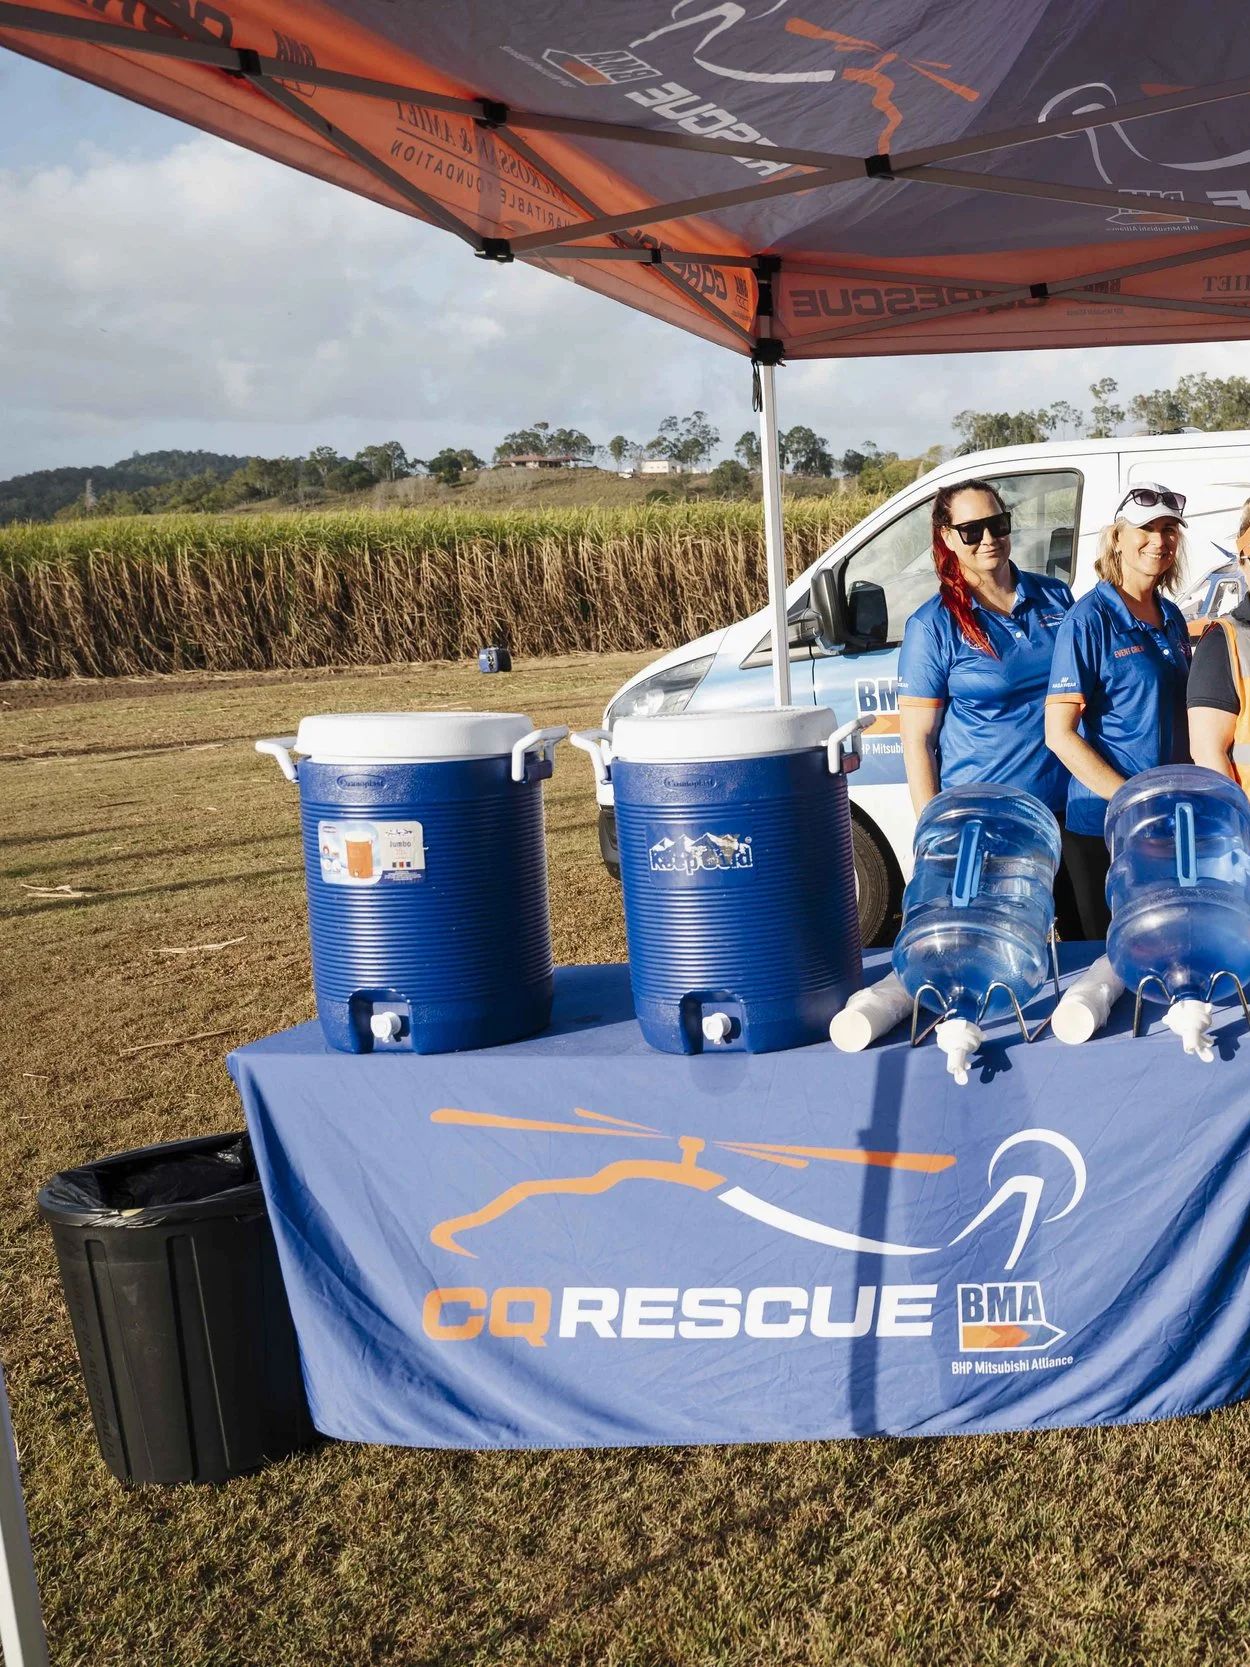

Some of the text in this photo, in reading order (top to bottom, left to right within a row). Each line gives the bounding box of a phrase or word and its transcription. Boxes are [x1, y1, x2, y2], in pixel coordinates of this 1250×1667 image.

[1114, 649, 1131, 659] EVENT
[857, 680, 900, 712] BM
[873, 742, 904, 754] Mitsubi
[390, 840, 412, 848] Jumbo
[960, 1284, 1044, 1323] BMA
[423, 1284, 938, 1347] CQRESCUE
[952, 1355, 1074, 1375] BHP Mitsubishi Alliance
